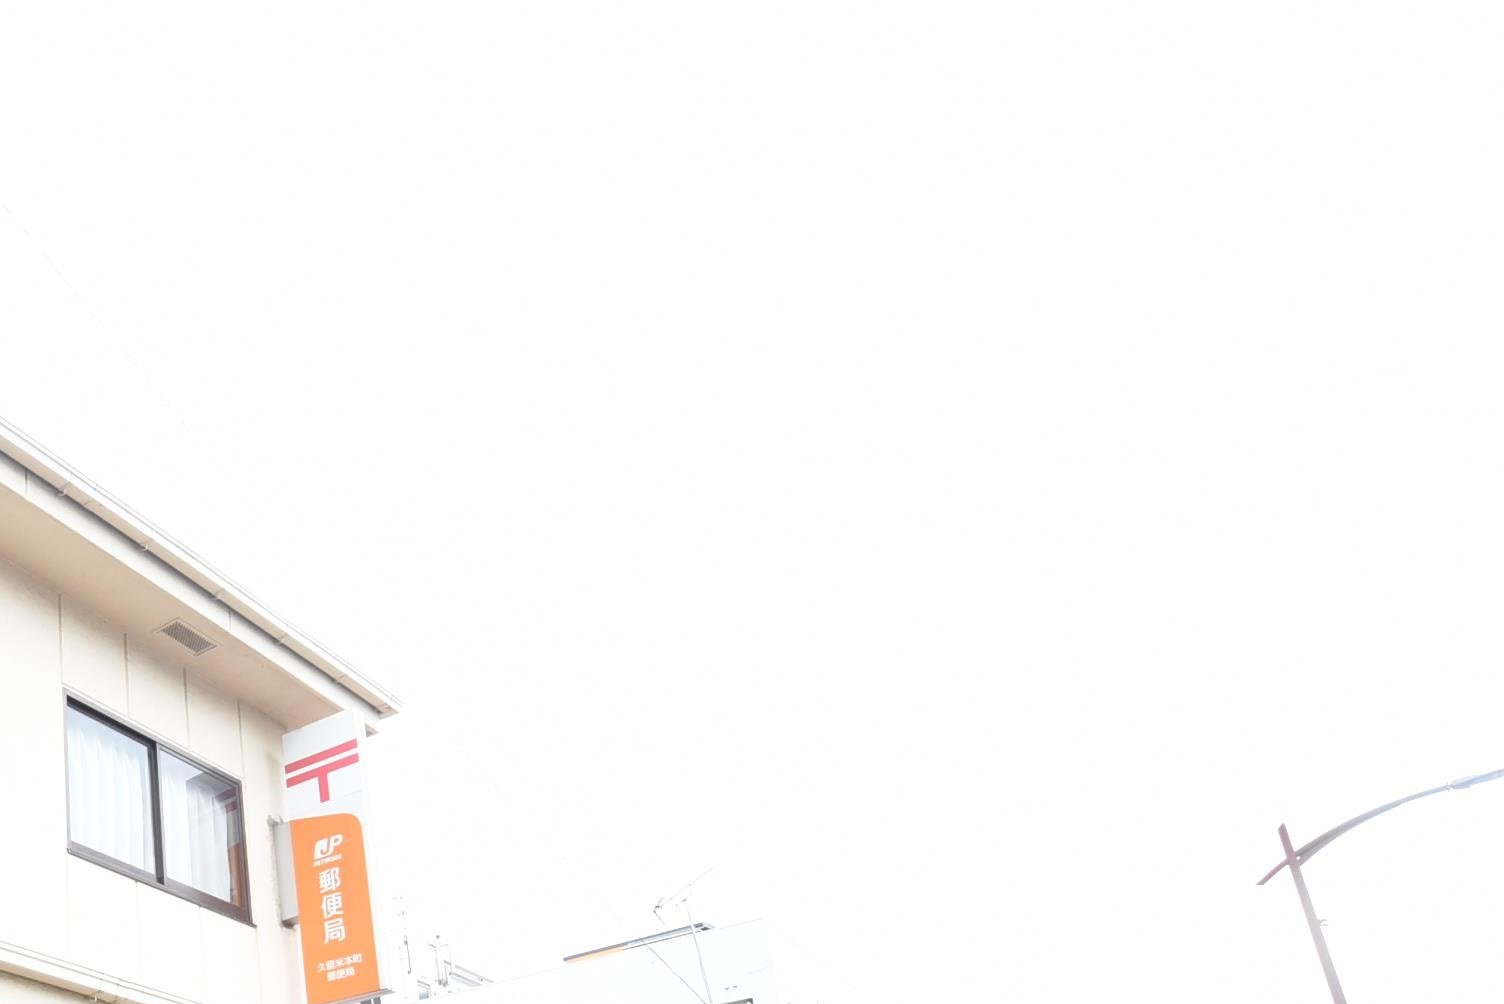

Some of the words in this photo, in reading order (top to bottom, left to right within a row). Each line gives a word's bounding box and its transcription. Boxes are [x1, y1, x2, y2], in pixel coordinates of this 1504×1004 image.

[314, 834, 343, 860] JP
[319, 867, 346, 944] 郵便局
[317, 953, 362, 973] 久留米本町
[326, 966, 355, 982] 郵便局
